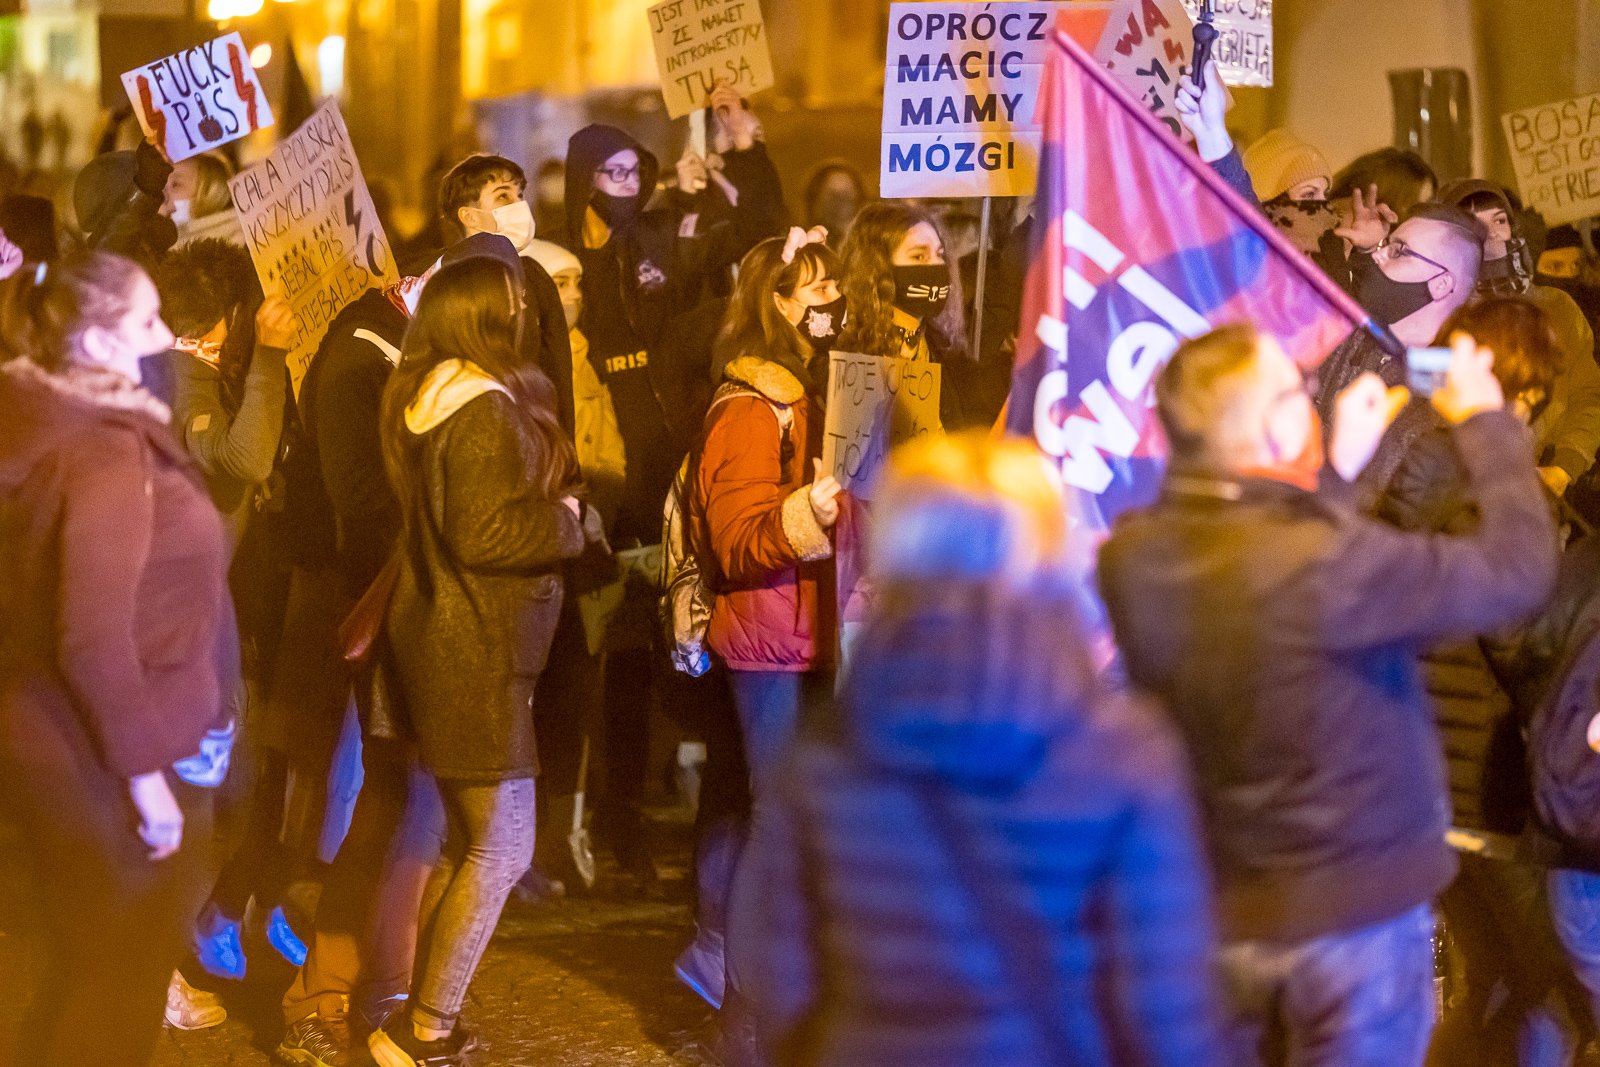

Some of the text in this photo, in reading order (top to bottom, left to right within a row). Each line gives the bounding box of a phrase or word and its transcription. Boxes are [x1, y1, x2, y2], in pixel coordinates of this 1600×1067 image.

[651, 1, 682, 33] JEST
[701, 3, 745, 32] NAWET
[898, 2, 1048, 41] OPRÓCZ
[147, 41, 231, 105] FUCK
[675, 67, 716, 104] TU
[897, 51, 1024, 83] MACIC
[900, 93, 1024, 126] MAMY
[281, 108, 344, 177] POLSKA
[888, 134, 1015, 173] MÓZGI
[247, 173, 317, 256] KRZYCZY
